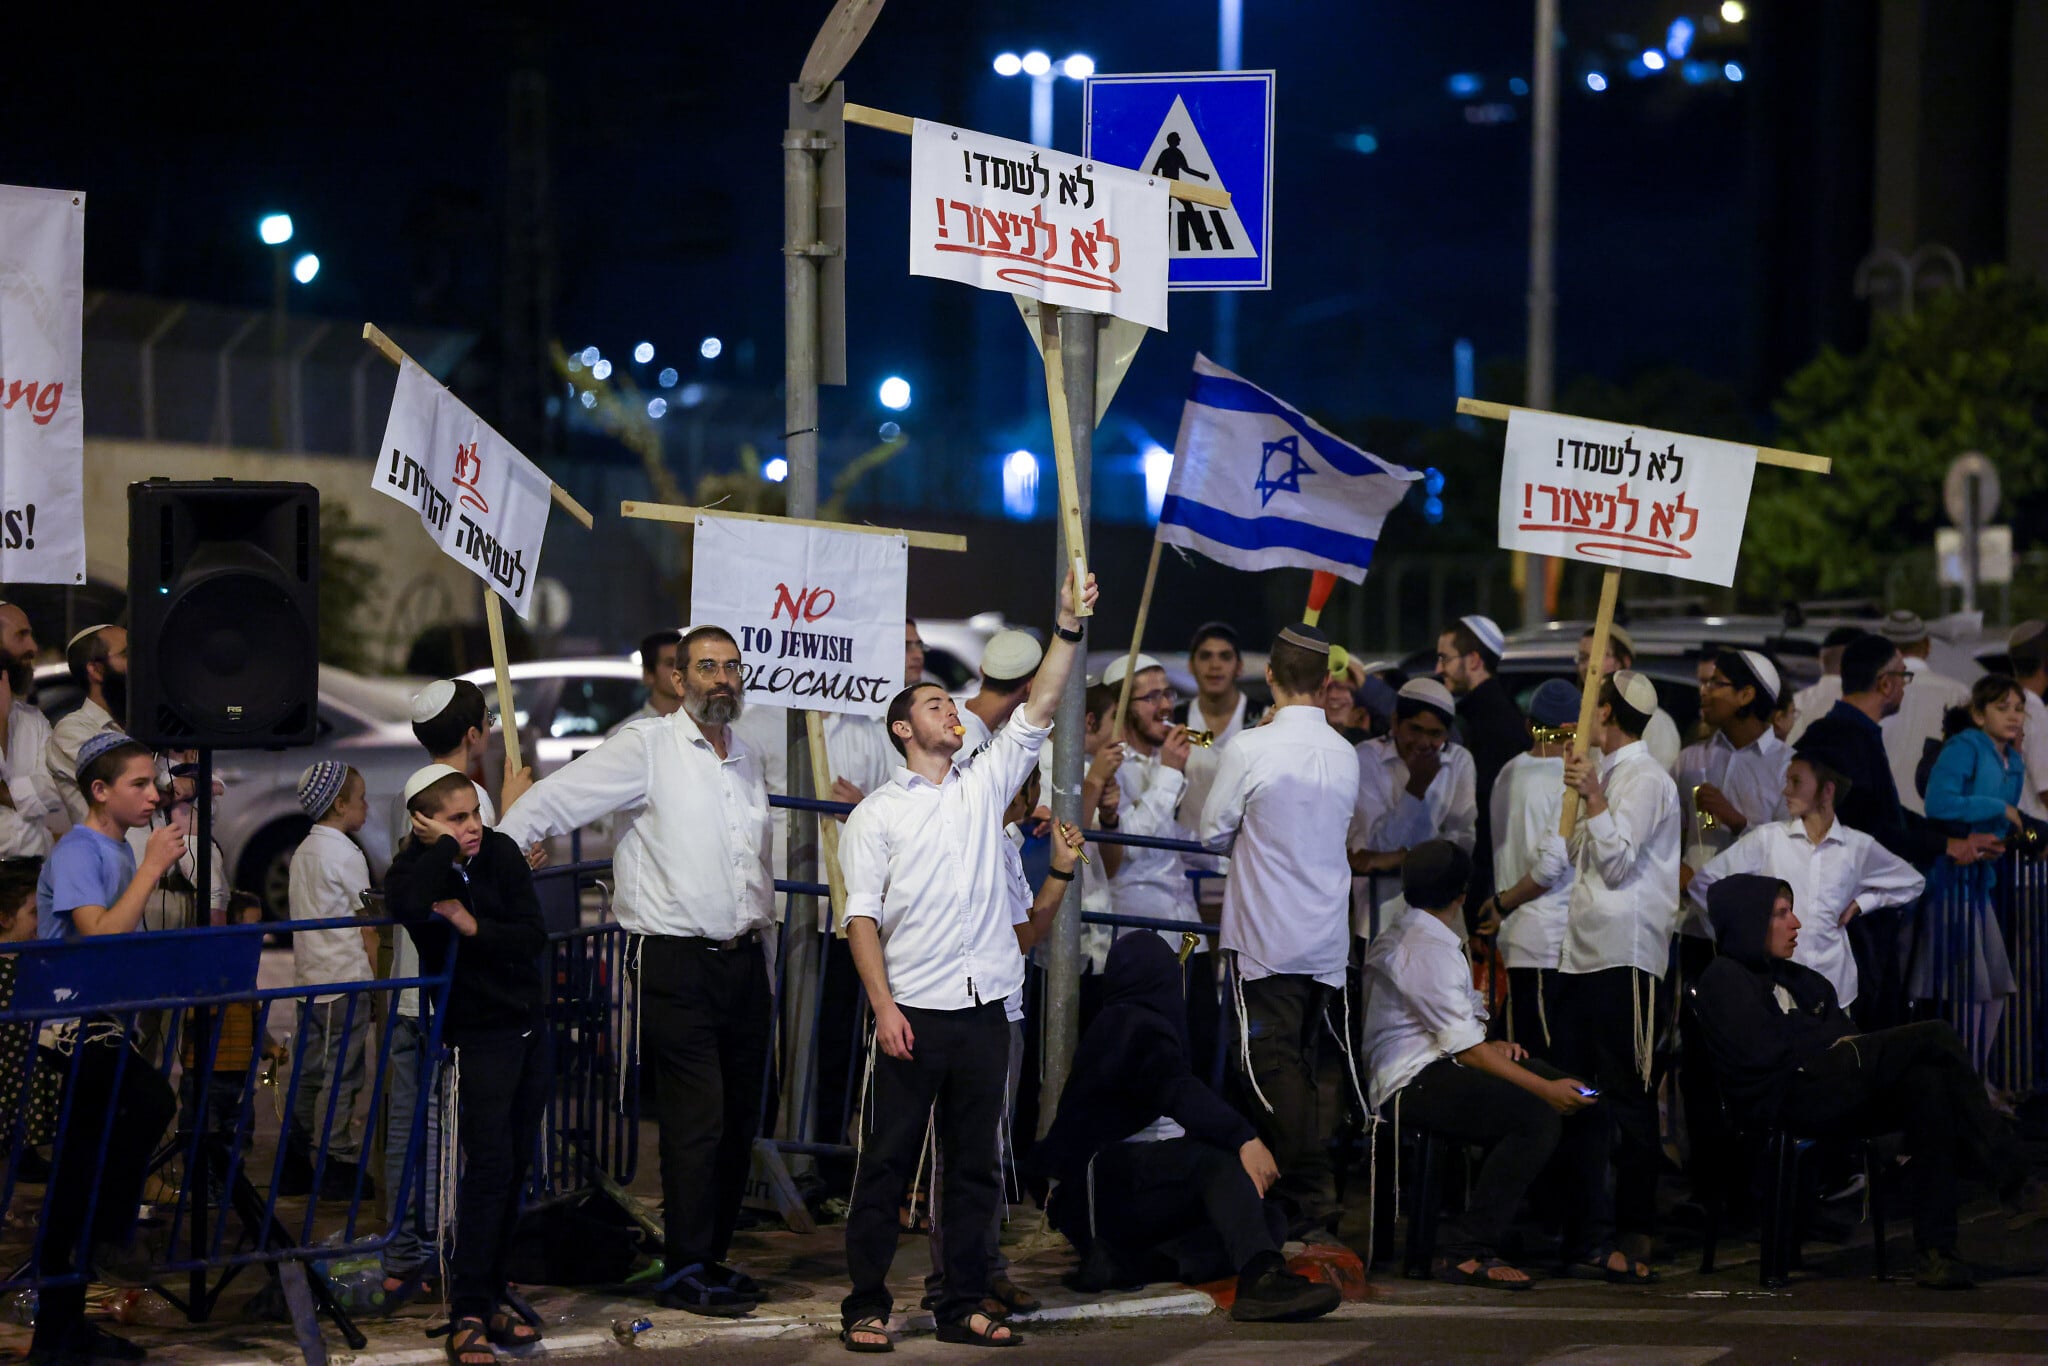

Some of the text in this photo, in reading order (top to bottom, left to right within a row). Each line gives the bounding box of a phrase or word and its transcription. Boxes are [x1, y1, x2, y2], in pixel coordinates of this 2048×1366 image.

[963, 150, 1095, 210] לא לשמד!
[934, 197, 1121, 273] לא לניצור!
[0, 378, 64, 425] ng
[455, 442, 482, 485] לא
[1556, 438, 1684, 484] לא לשמד!
[0, 503, 36, 550] s!
[1523, 482, 1699, 542] לא לניצור!
[455, 513, 527, 598] לשואה
[771, 582, 836, 623] NO
[740, 626, 854, 664] TO JEWISH
